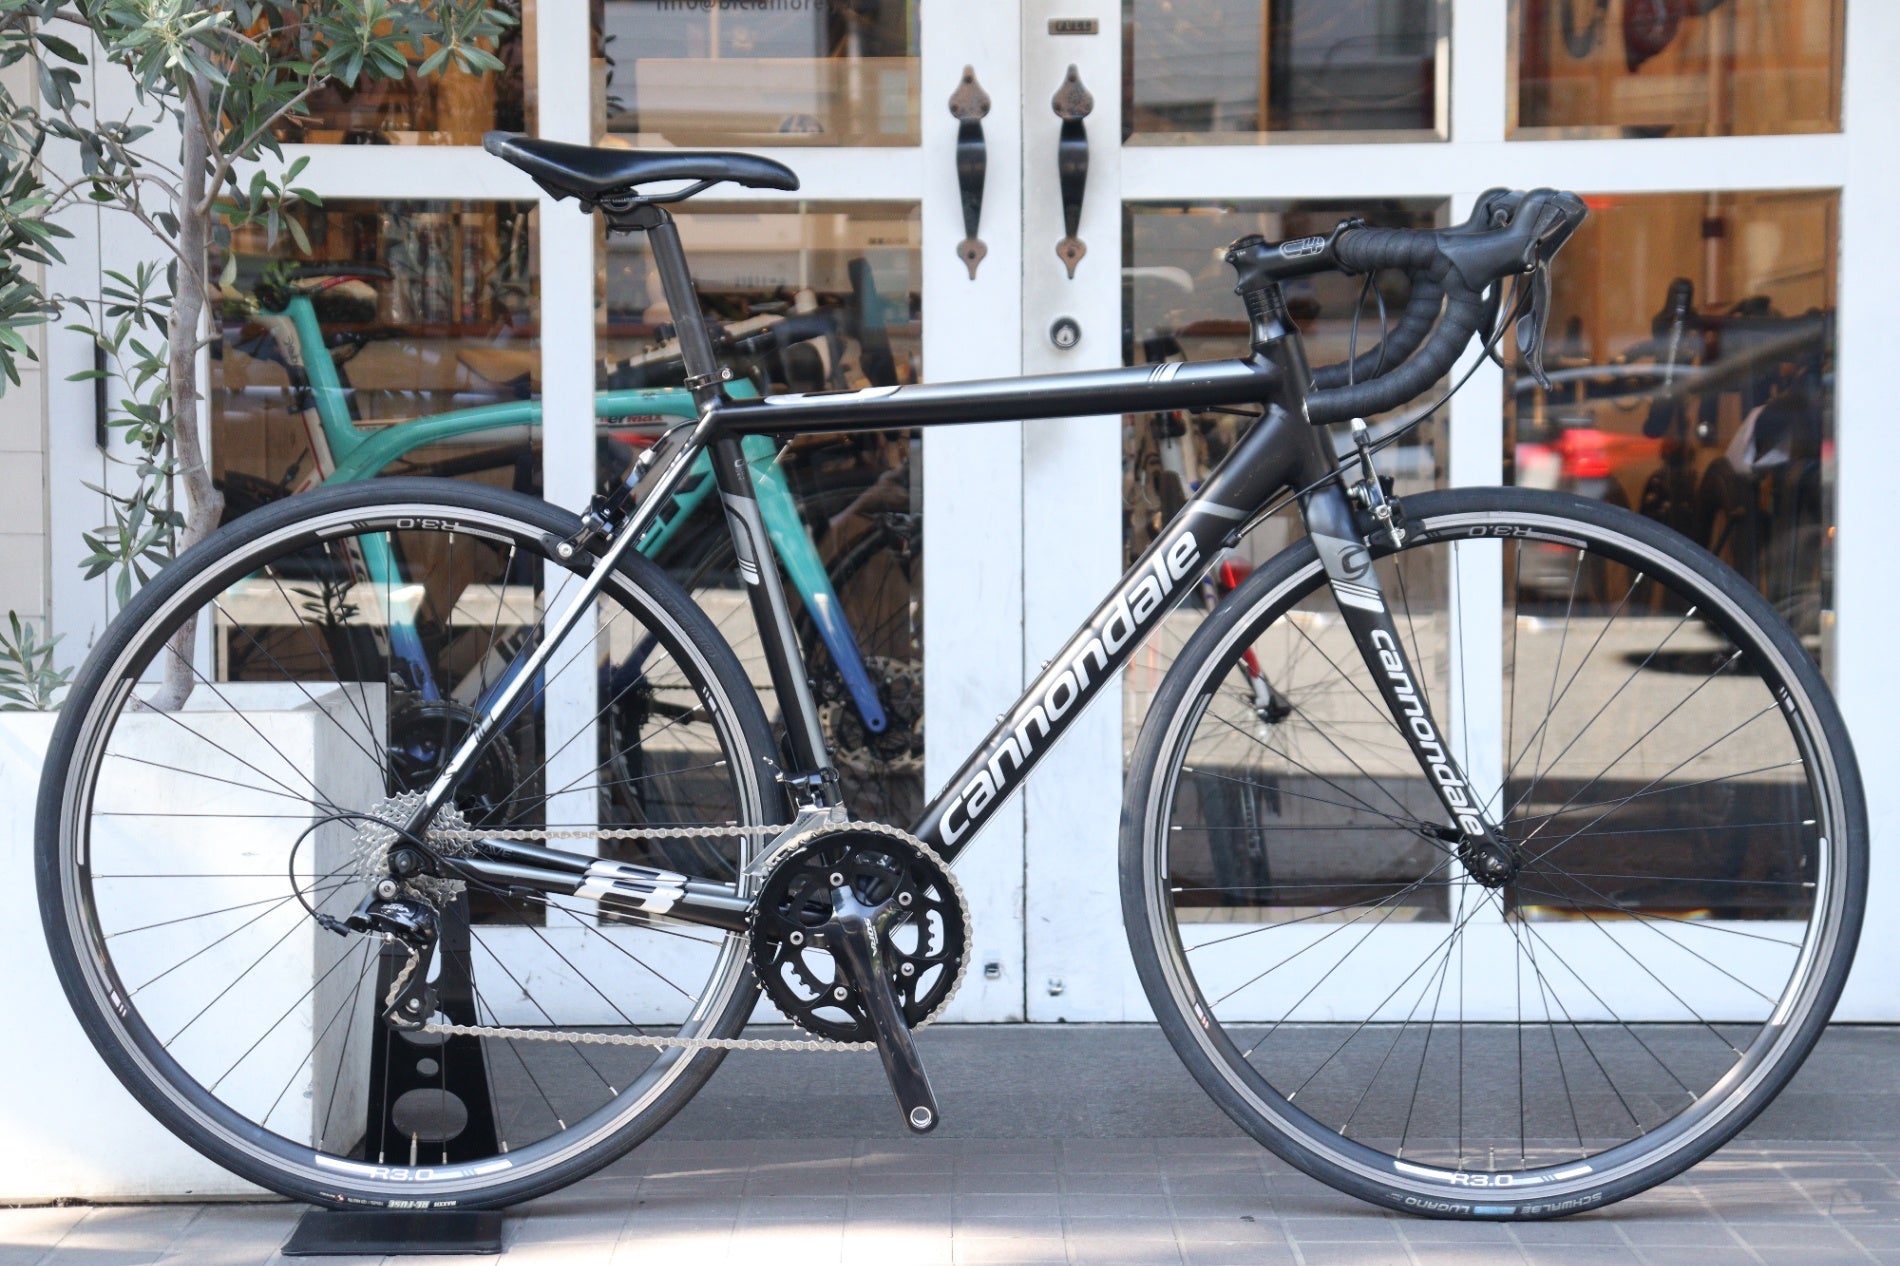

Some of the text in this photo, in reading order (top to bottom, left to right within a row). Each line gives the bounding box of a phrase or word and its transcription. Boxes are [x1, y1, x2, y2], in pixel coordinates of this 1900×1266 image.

[396, 518, 460, 531] R3.0
[1468, 525, 1532, 537] R3.0
[939, 531, 1201, 846] cannondale
[1370, 629, 1485, 836] cannondale
[369, 1167, 434, 1181] R3.0
[1450, 1173, 1513, 1187] R3.0
[1404, 1196, 1471, 1213] LUGANO
[1521, 1192, 1603, 1214] SCHWALBE
